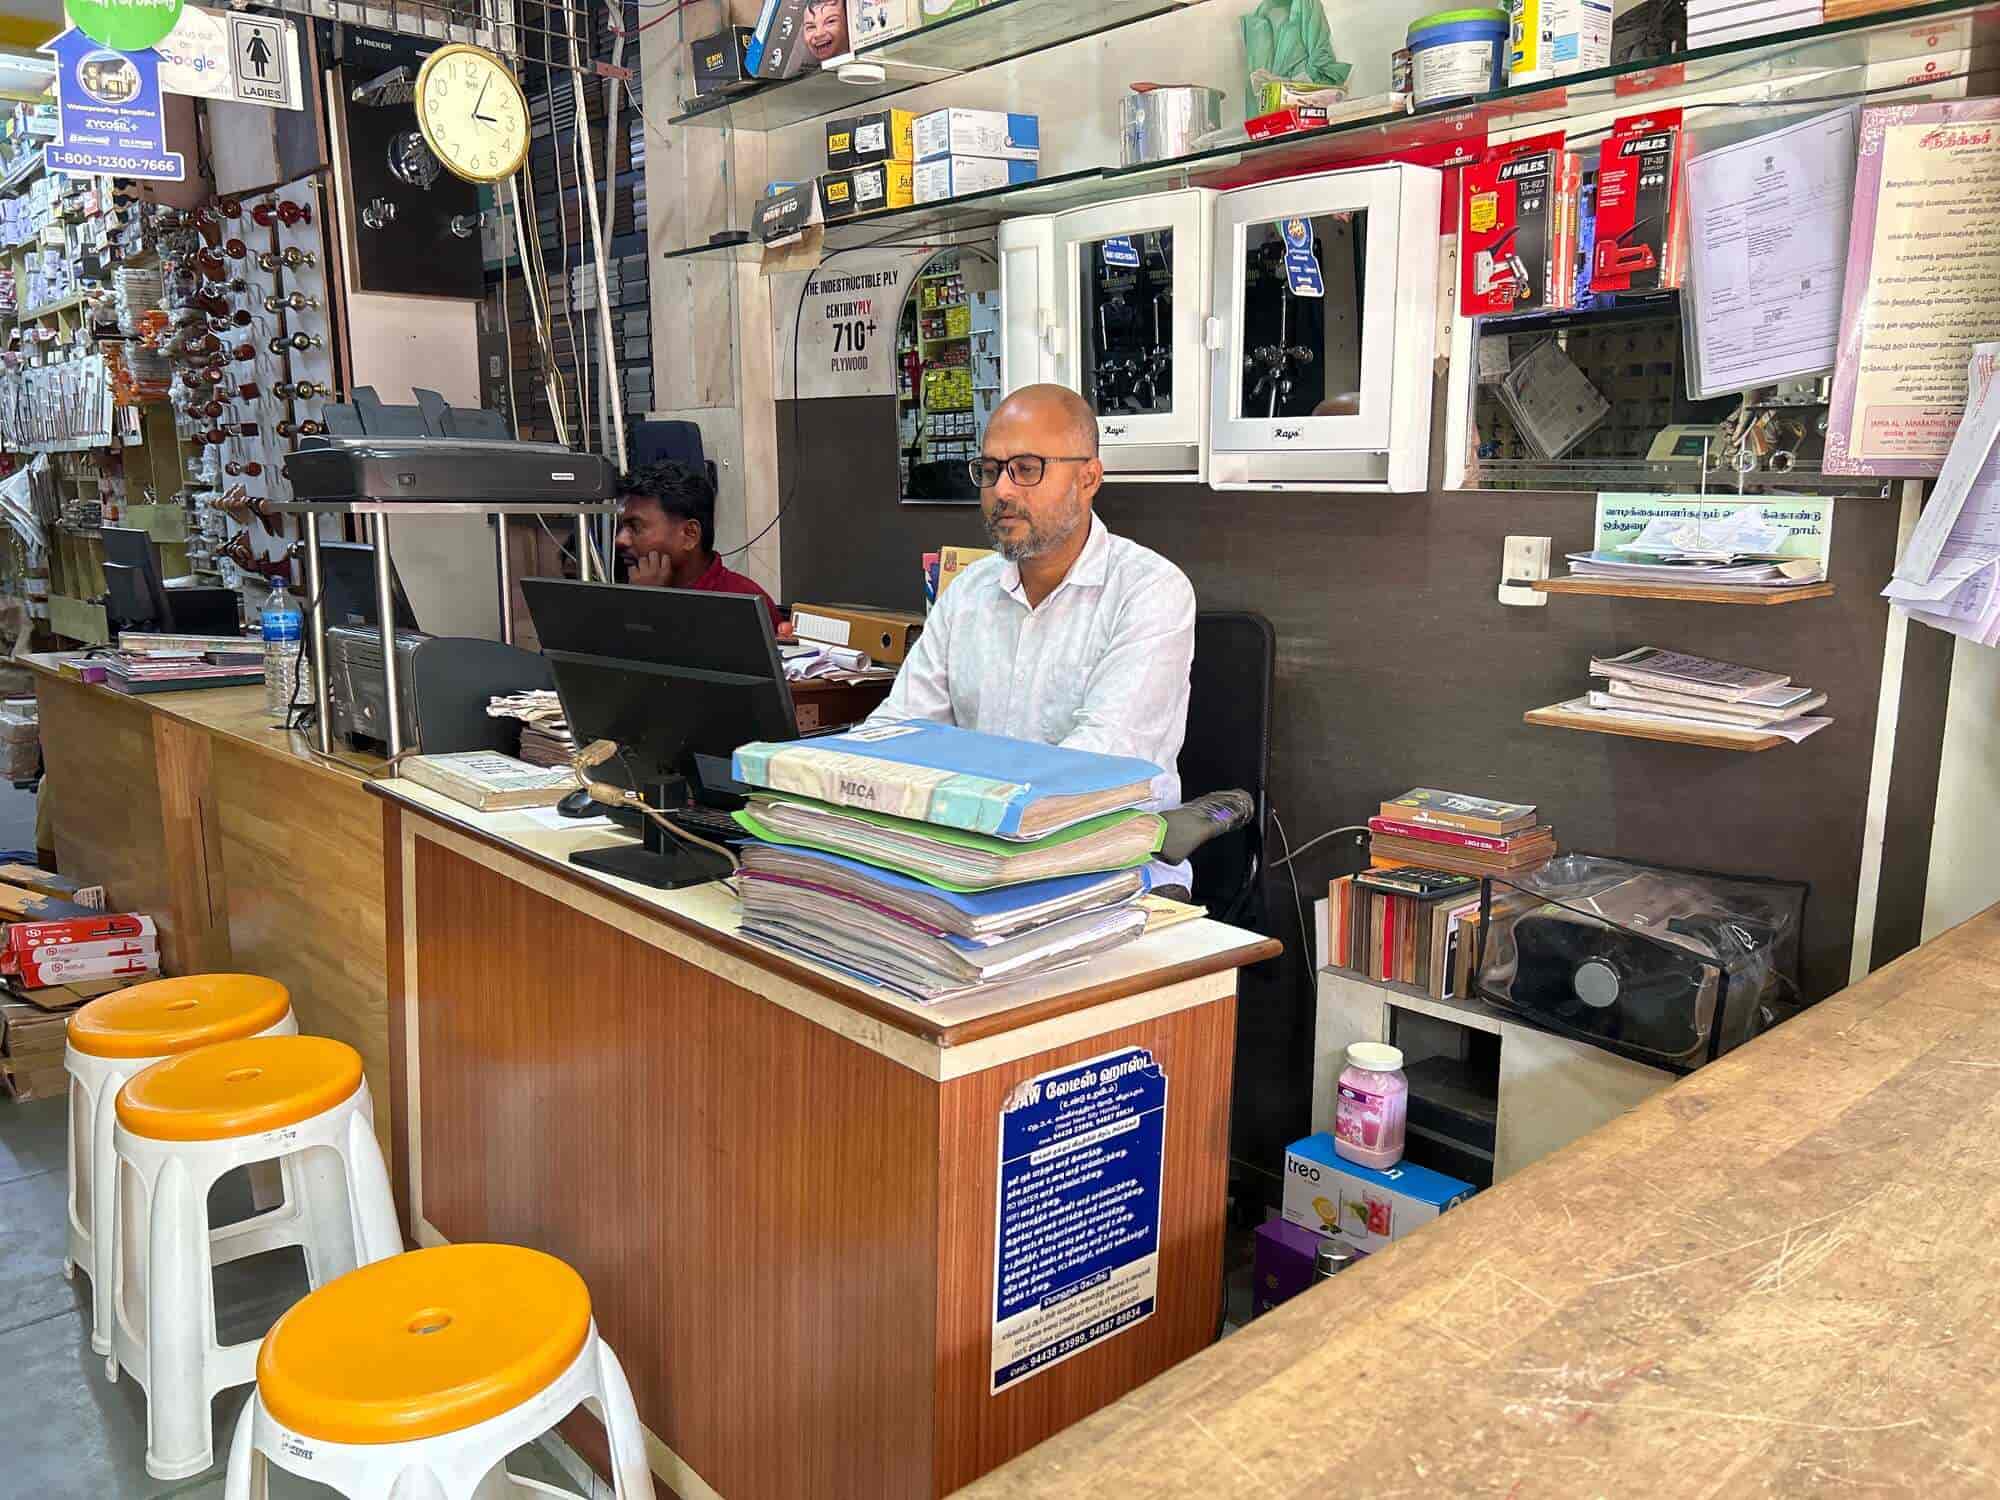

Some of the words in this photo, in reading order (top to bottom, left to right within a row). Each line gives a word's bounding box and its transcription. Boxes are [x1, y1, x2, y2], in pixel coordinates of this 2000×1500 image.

[244, 86, 281, 99] LADIES
[1635, 138, 1666, 152] MILES
[53, 152, 175, 172] 1-800-12300-7666
[1513, 160, 1545, 176] MILES
[806, 278, 820, 296] THE
[820, 271, 882, 296] INDESTRUCTIBLE
[882, 270, 899, 287] PLY
[826, 300, 872, 319] CENTURYPLY
[831, 356, 868, 373] PLYWOOD
[839, 780, 876, 801] MICA
[1288, 1155, 1321, 1182] treo
